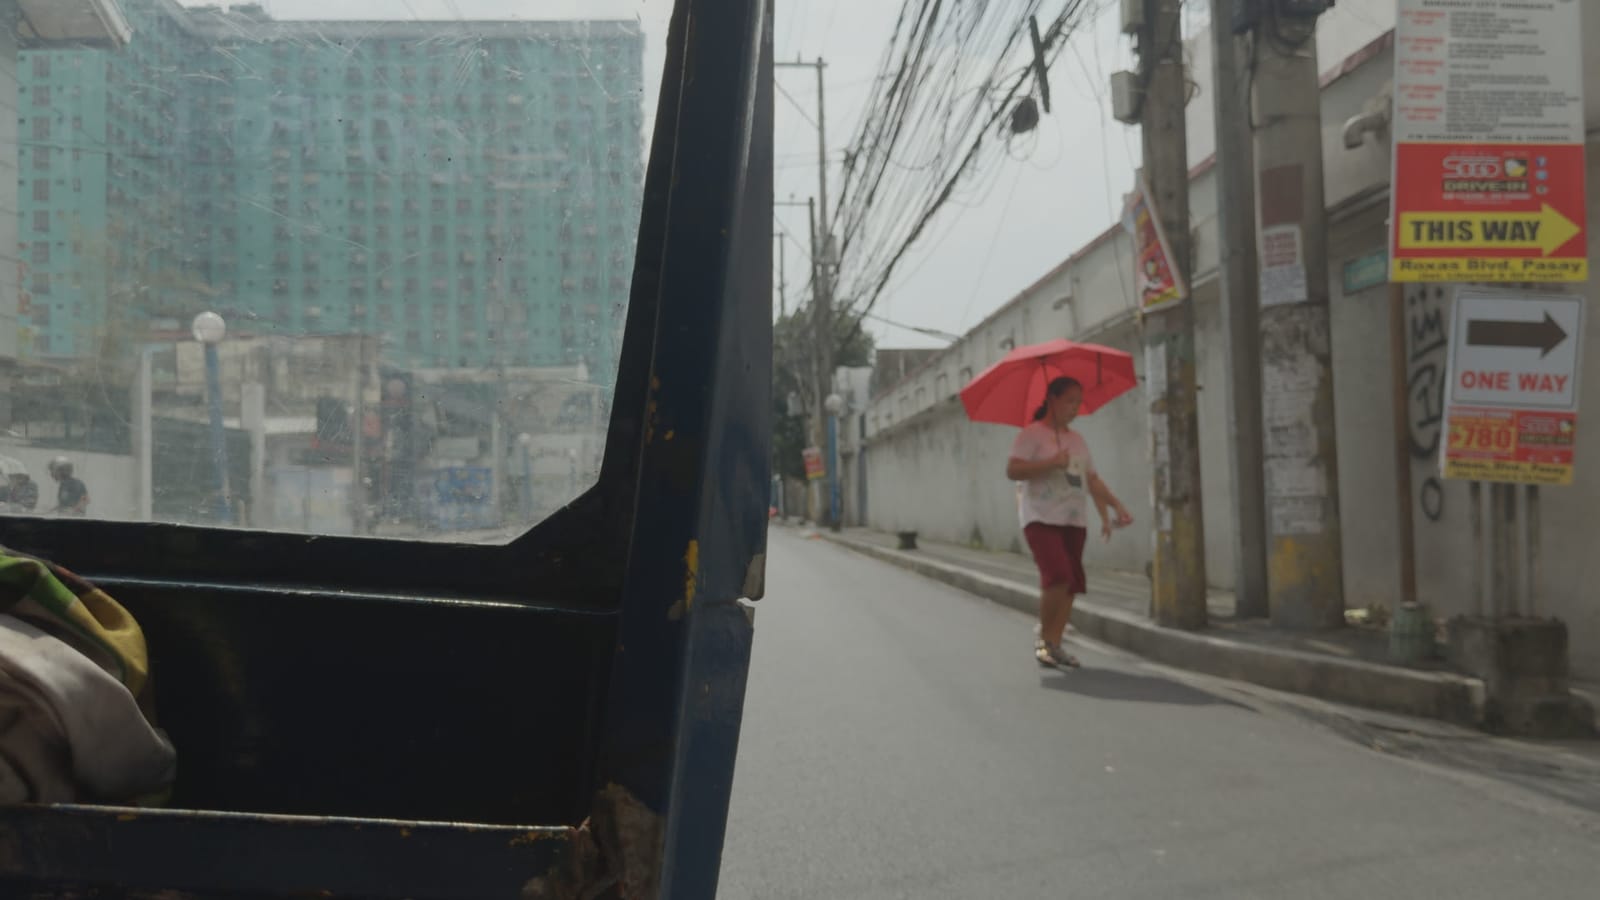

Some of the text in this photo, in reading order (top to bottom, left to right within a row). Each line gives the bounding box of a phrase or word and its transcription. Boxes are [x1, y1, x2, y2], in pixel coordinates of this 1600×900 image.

[1410, 220, 1541, 241] THIS WAY
[1399, 259, 1459, 271] Roxas
[1522, 259, 1582, 273] Pasay
[1460, 371, 1569, 393] ONE WAY
